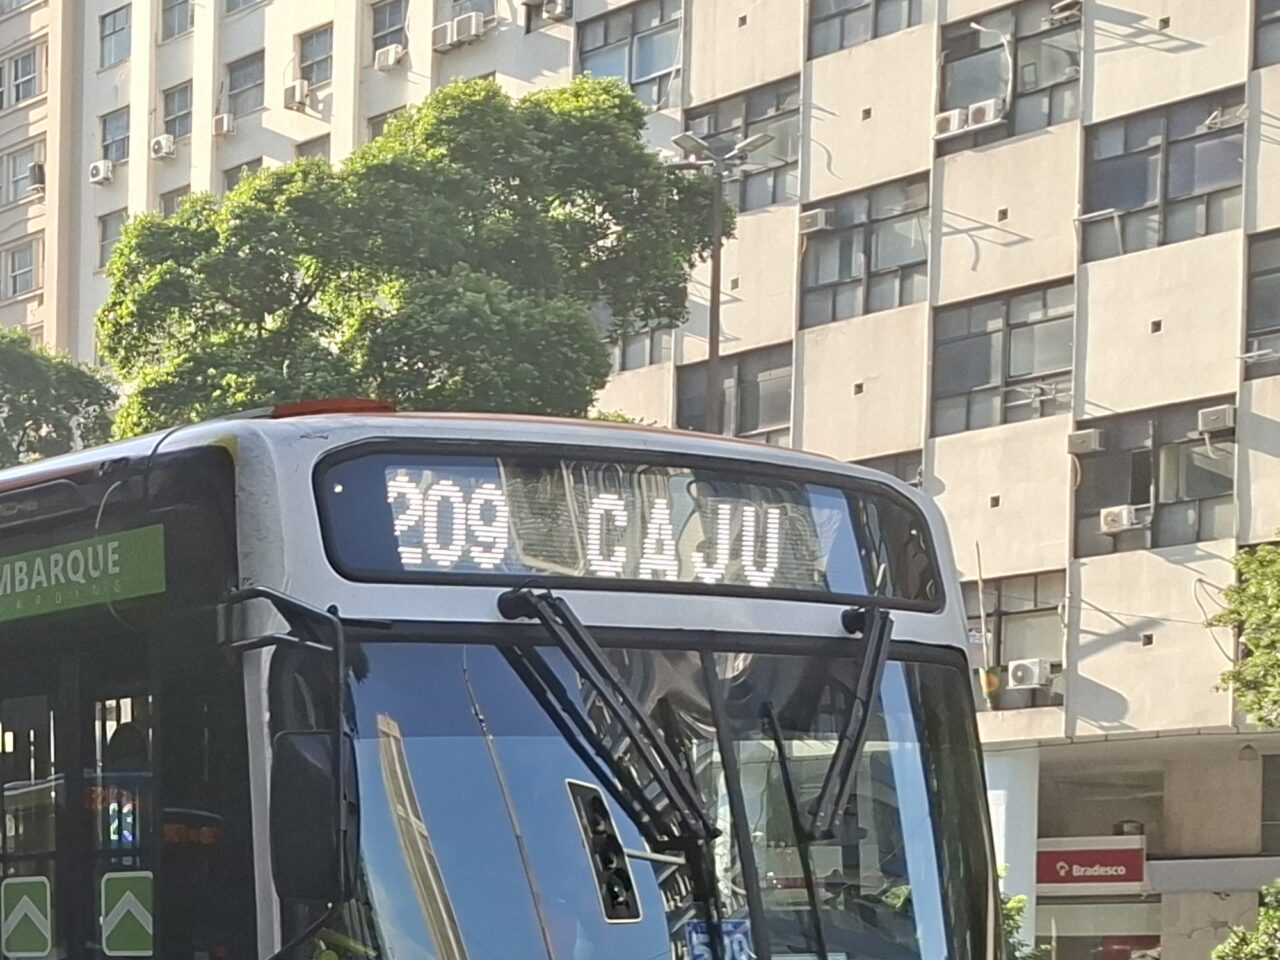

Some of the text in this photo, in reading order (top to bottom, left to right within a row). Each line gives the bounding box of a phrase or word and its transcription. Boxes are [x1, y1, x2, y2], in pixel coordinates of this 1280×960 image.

[387, 475, 781, 588] 209 CAJU
[1072, 864, 1126, 876] Bradesco
